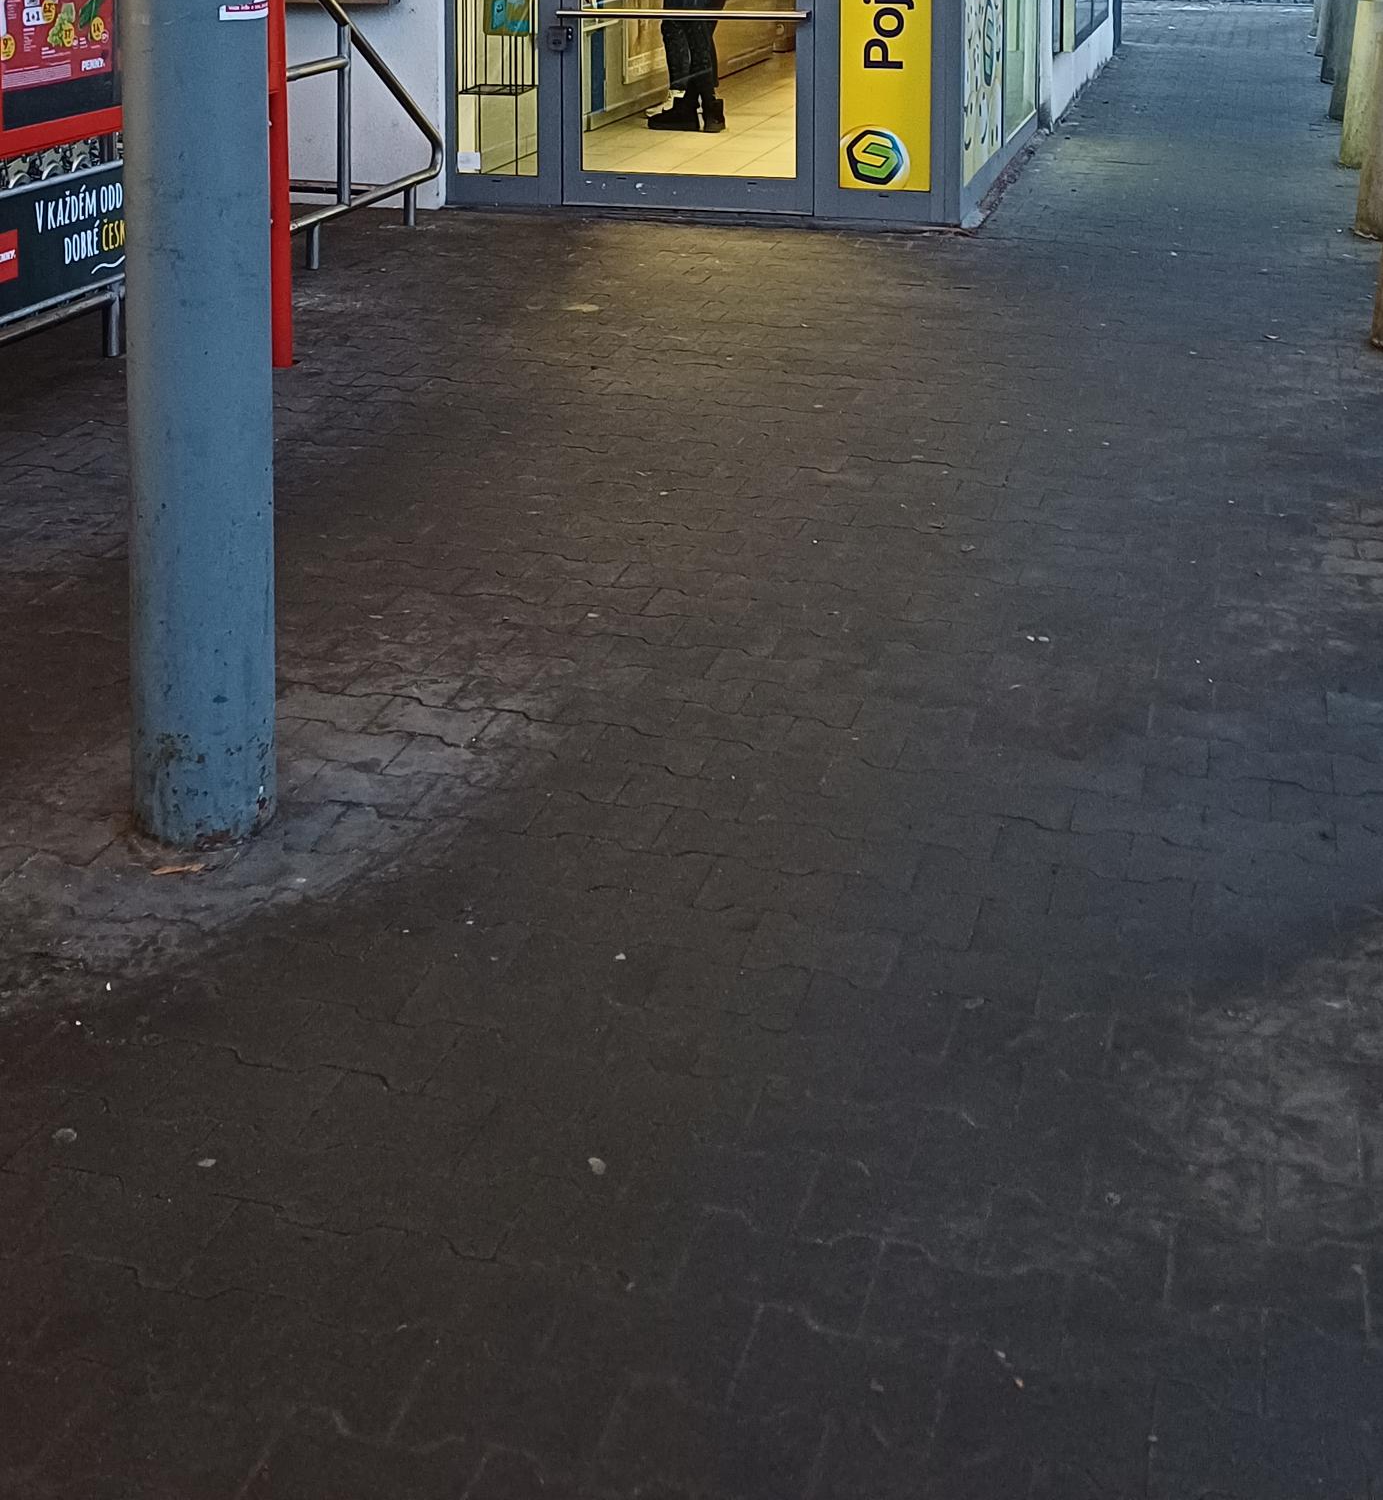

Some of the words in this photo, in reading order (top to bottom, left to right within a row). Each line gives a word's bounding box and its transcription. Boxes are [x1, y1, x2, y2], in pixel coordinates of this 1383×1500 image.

[35, 200, 43, 233] V
[47, 184, 96, 230] KAŽDÉM
[100, 182, 122, 213] ODD
[64, 219, 99, 265] DOBRÉ
